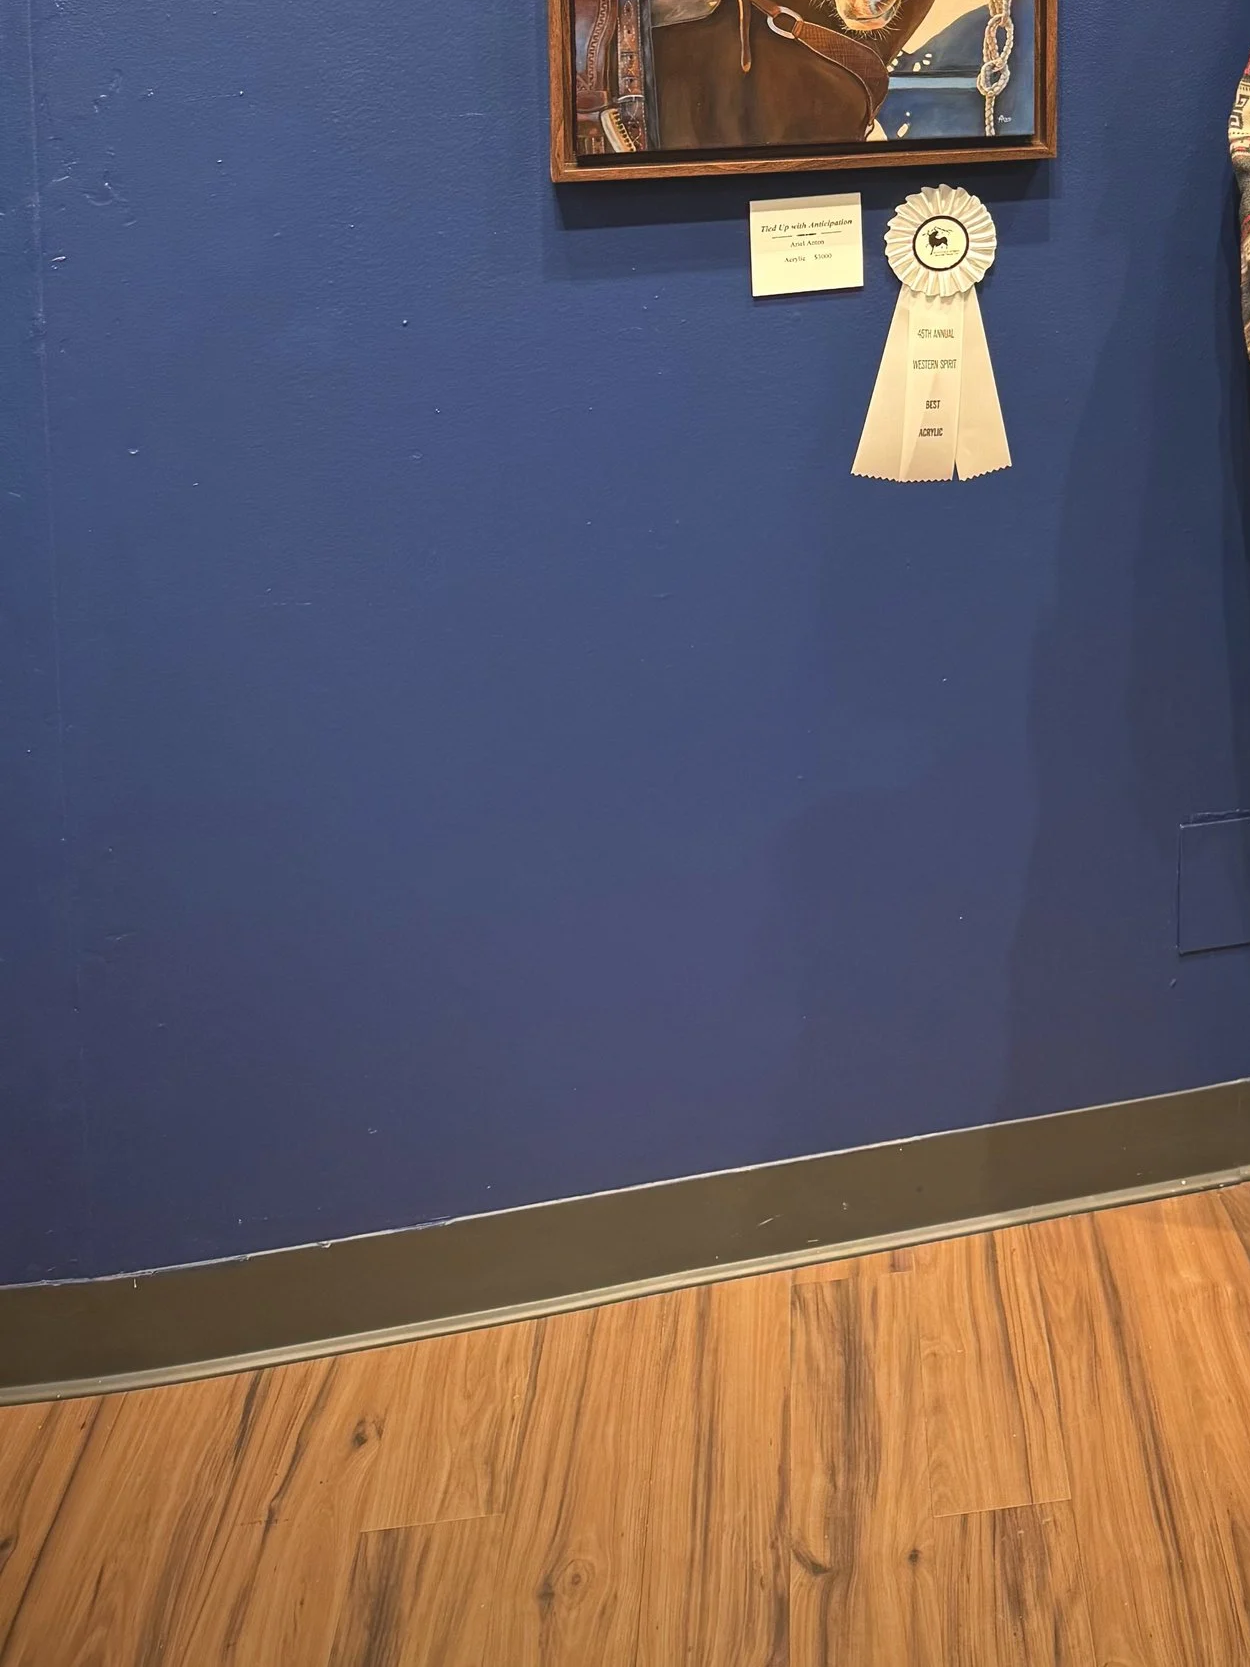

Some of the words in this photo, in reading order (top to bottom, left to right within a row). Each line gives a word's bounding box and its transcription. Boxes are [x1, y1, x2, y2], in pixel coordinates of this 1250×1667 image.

[761, 224, 777, 233] Tied
[779, 224, 789, 233] Up
[791, 222, 807, 230] with
[808, 218, 853, 229] Anticipation
[917, 329, 931, 338] 45TH
[933, 329, 954, 338] ANNUAL
[913, 359, 938, 369] WESTERN
[940, 359, 957, 369] SPIRIT
[925, 400, 941, 409] BEST
[918, 428, 943, 437] ACRYLIC
